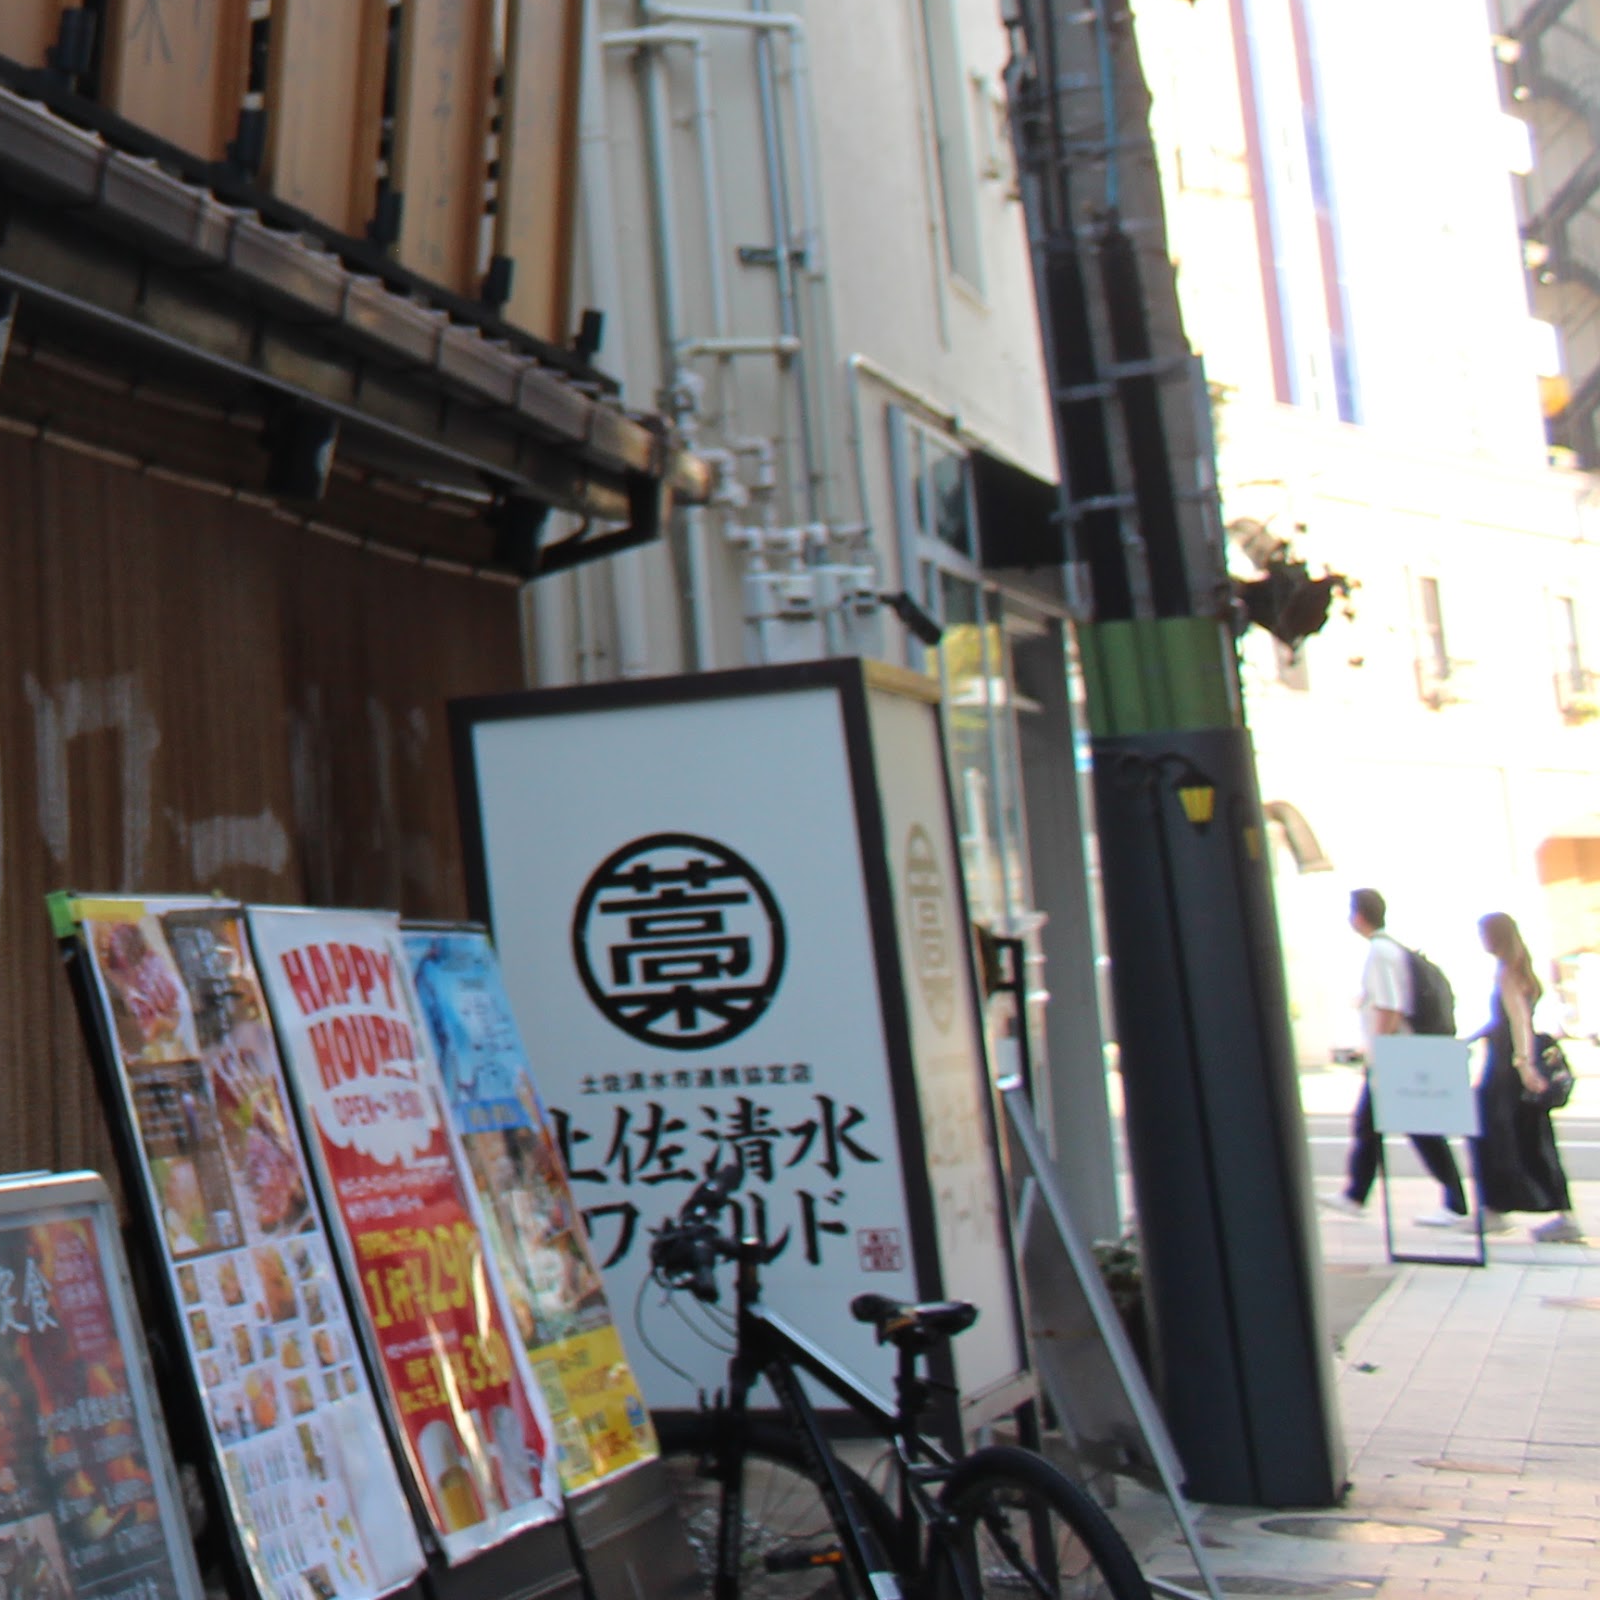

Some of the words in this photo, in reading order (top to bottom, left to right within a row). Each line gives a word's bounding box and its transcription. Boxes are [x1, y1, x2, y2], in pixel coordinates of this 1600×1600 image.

[280, 941, 395, 1016] HAPPY
[581, 1186, 849, 1271] ワルド
